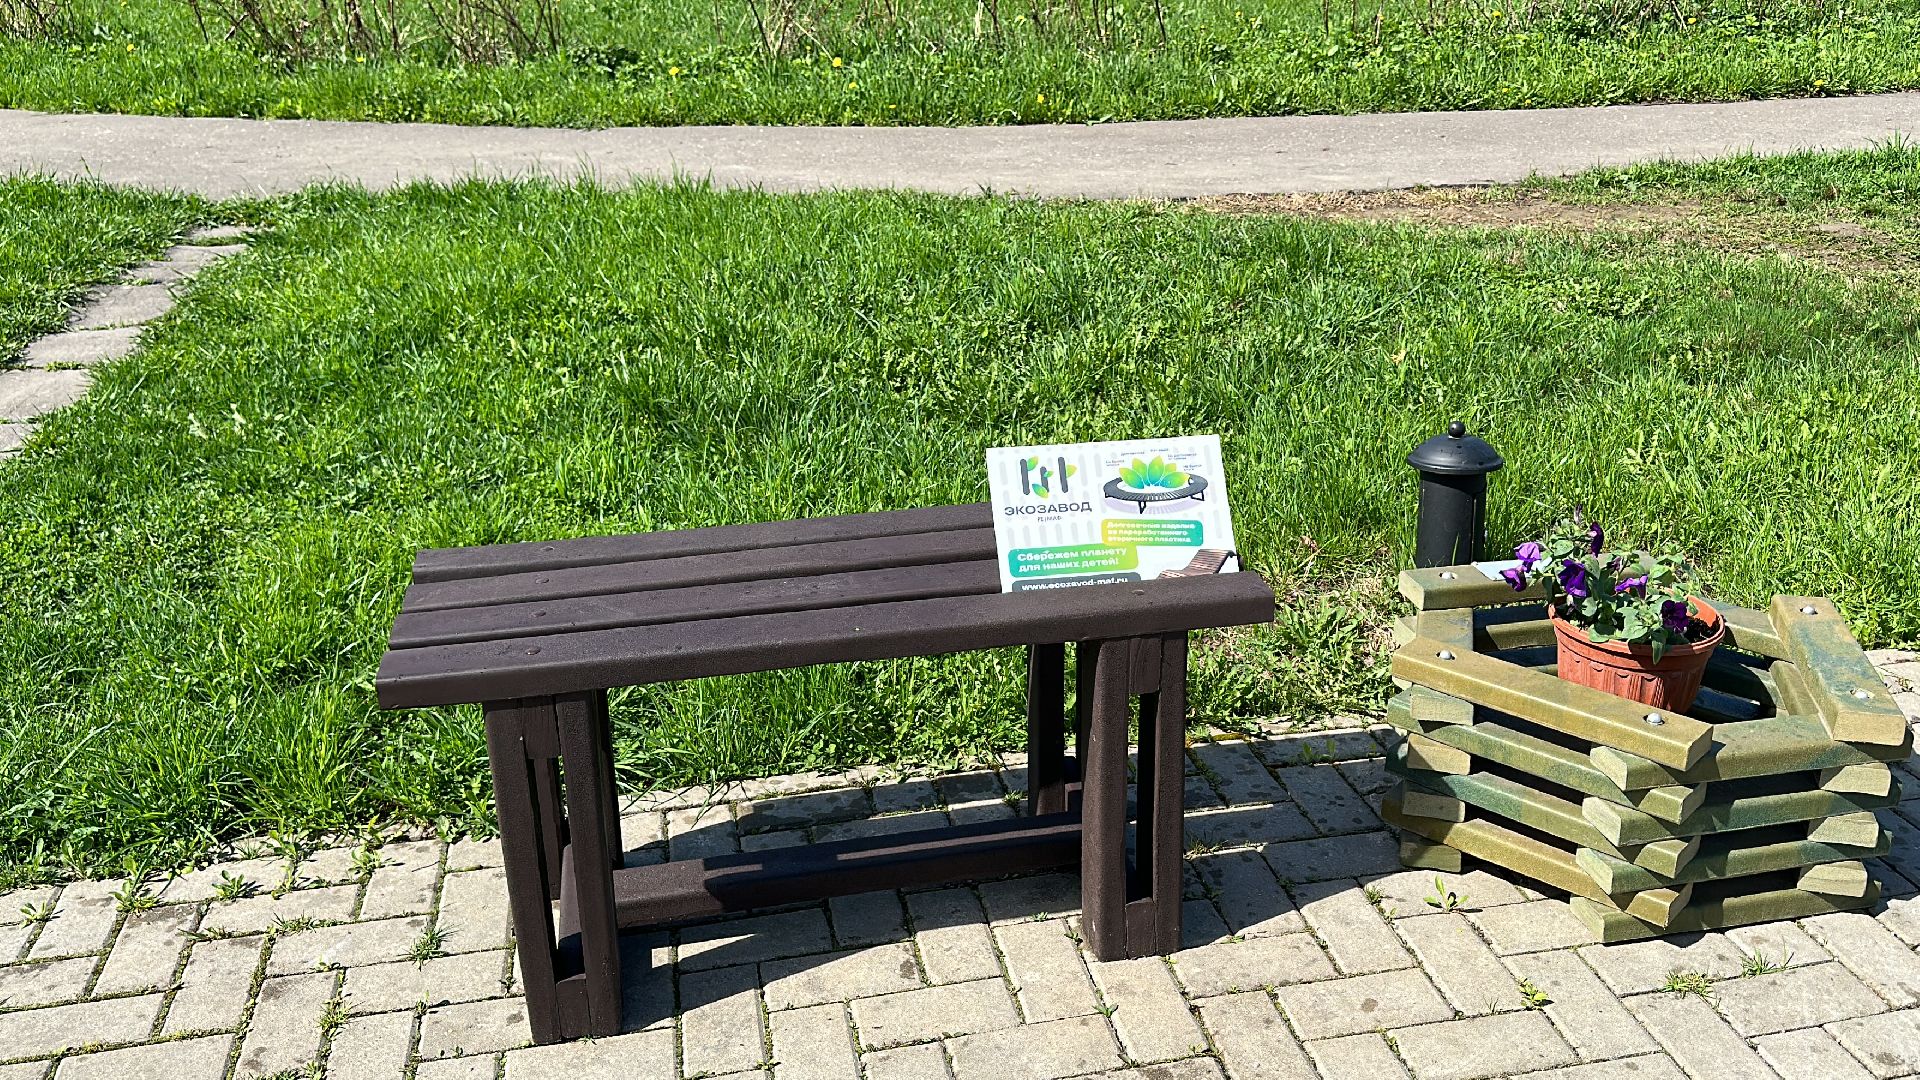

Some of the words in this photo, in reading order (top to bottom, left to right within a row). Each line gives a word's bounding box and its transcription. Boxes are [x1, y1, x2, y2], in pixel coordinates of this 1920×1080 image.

[1004, 502, 1092, 515] ЭКОЗАВОД
[1017, 551, 1079, 562] Сбережем
[1081, 548, 1127, 557] планету
[1019, 564, 1041, 573] для
[1043, 561, 1080, 570] наших
[1082, 557, 1119, 568] детей!
